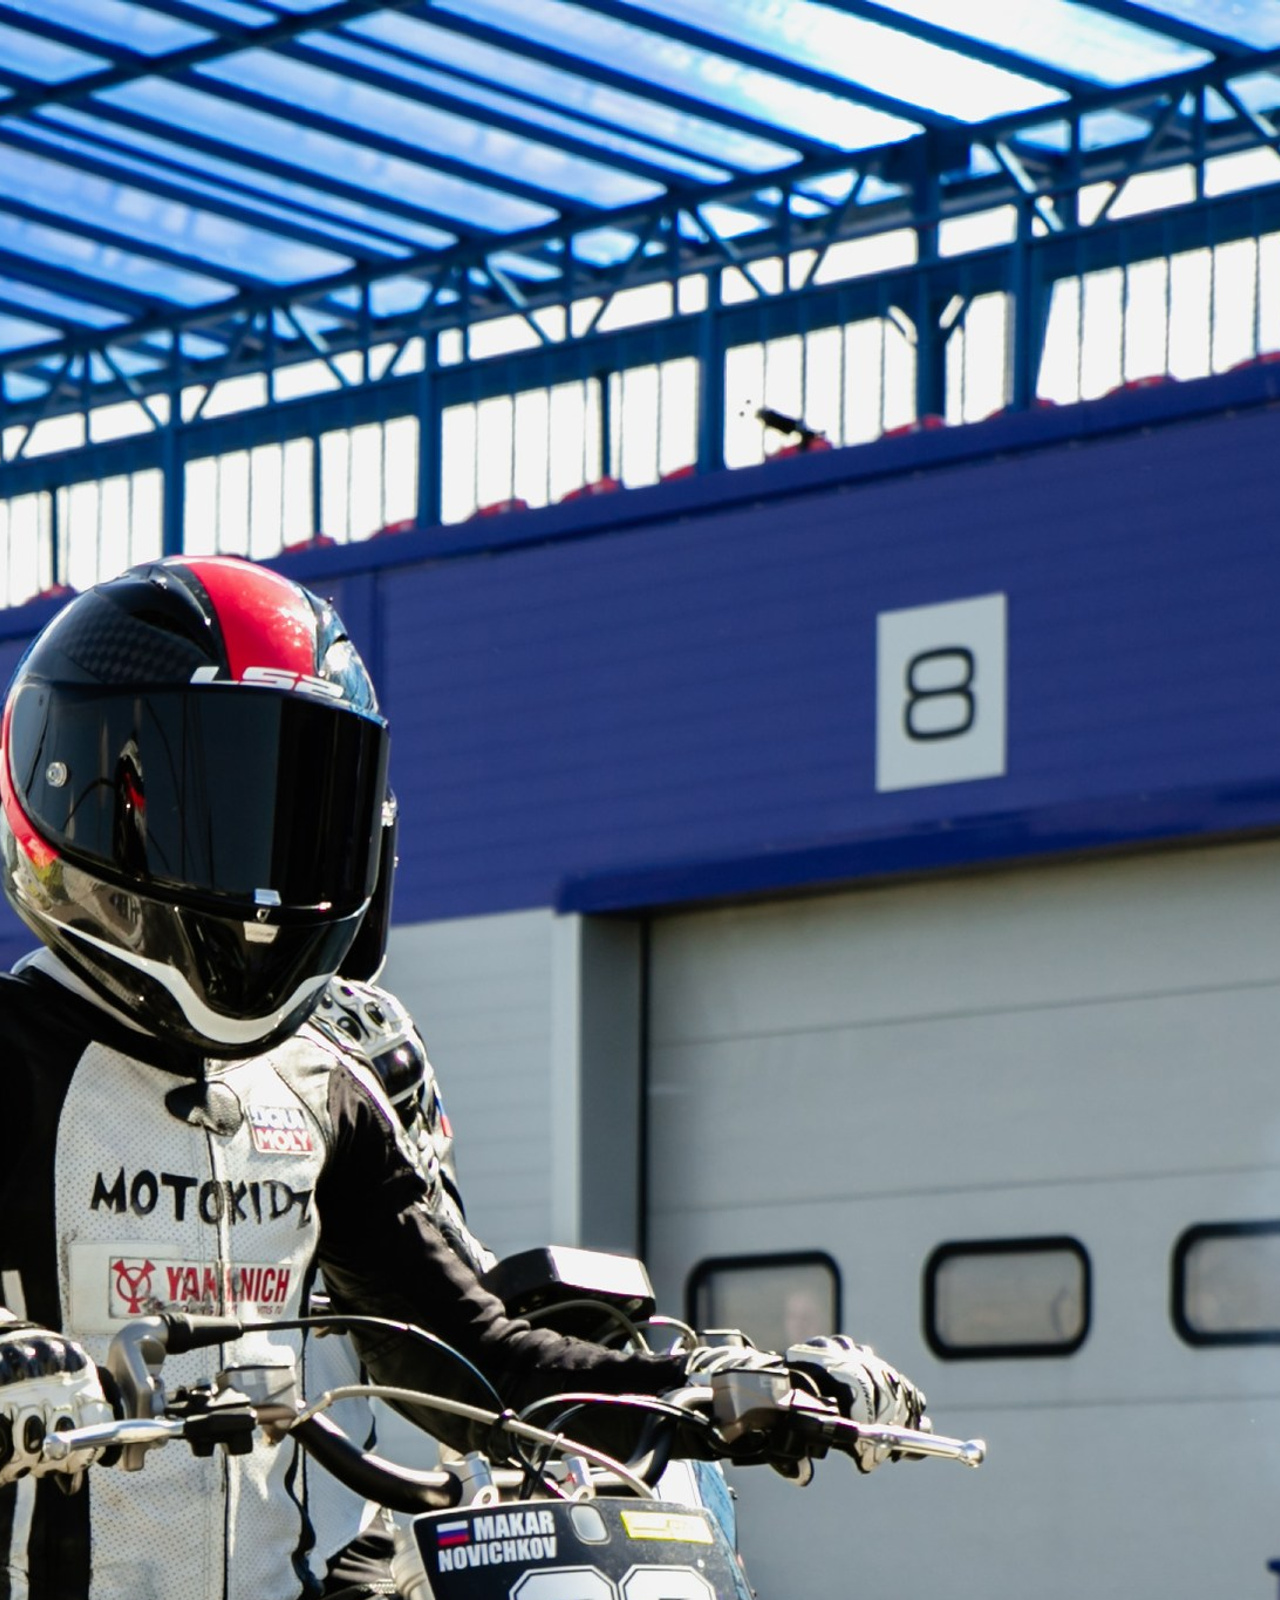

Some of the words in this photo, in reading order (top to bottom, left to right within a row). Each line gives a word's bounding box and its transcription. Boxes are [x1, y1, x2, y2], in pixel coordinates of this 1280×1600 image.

[189, 665, 345, 699] LS2
[904, 646, 976, 743] 8
[256, 1129, 313, 1152] MOLY
[90, 1166, 313, 1230] MOTOKIDZ
[473, 1510, 556, 1542] MAKAR
[438, 1536, 557, 1573] NOVICHKOV
